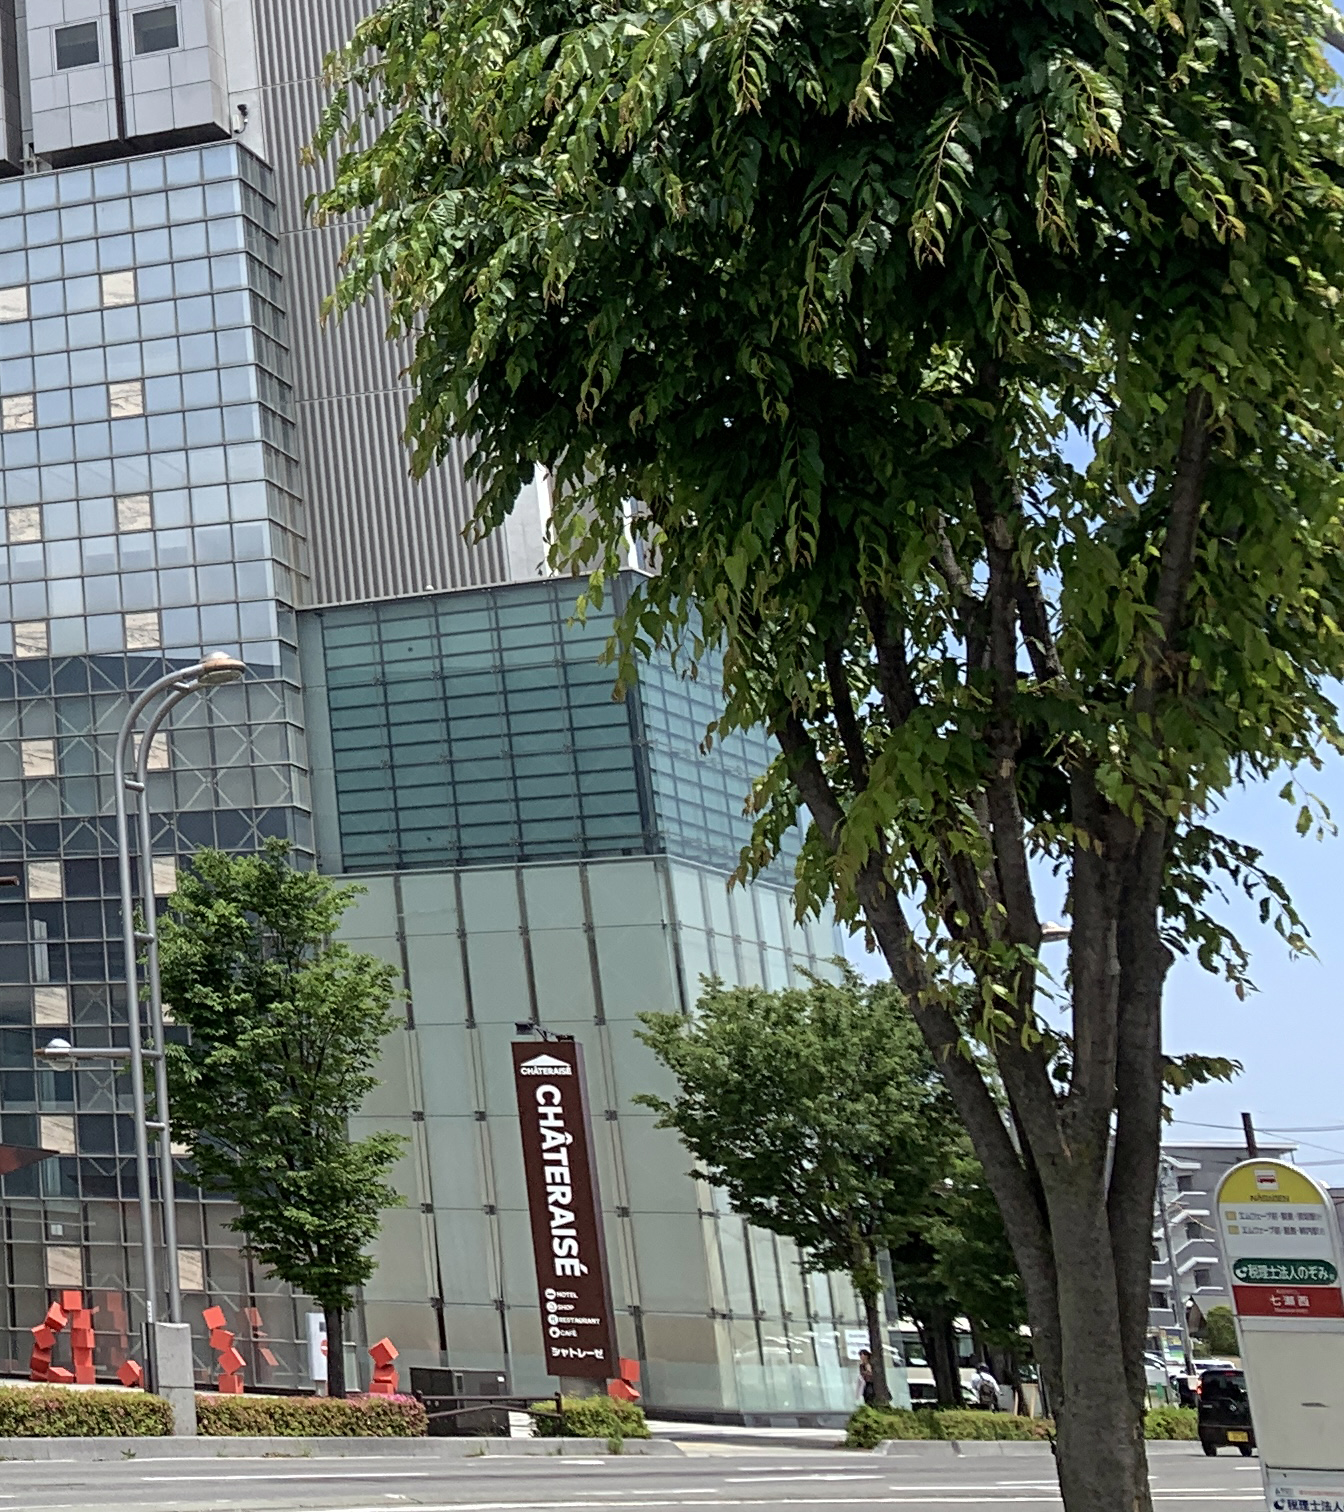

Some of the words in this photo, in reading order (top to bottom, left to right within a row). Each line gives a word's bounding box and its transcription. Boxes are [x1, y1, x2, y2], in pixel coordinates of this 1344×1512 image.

[520, 1066, 572, 1075] CHÂTERAISÉ
[536, 1084, 588, 1276] CHÂTERAISÉ
[1248, 1264, 1328, 1280] 税理士法人のぞみ
[551, 1347, 604, 1359] シャトレーゼ
